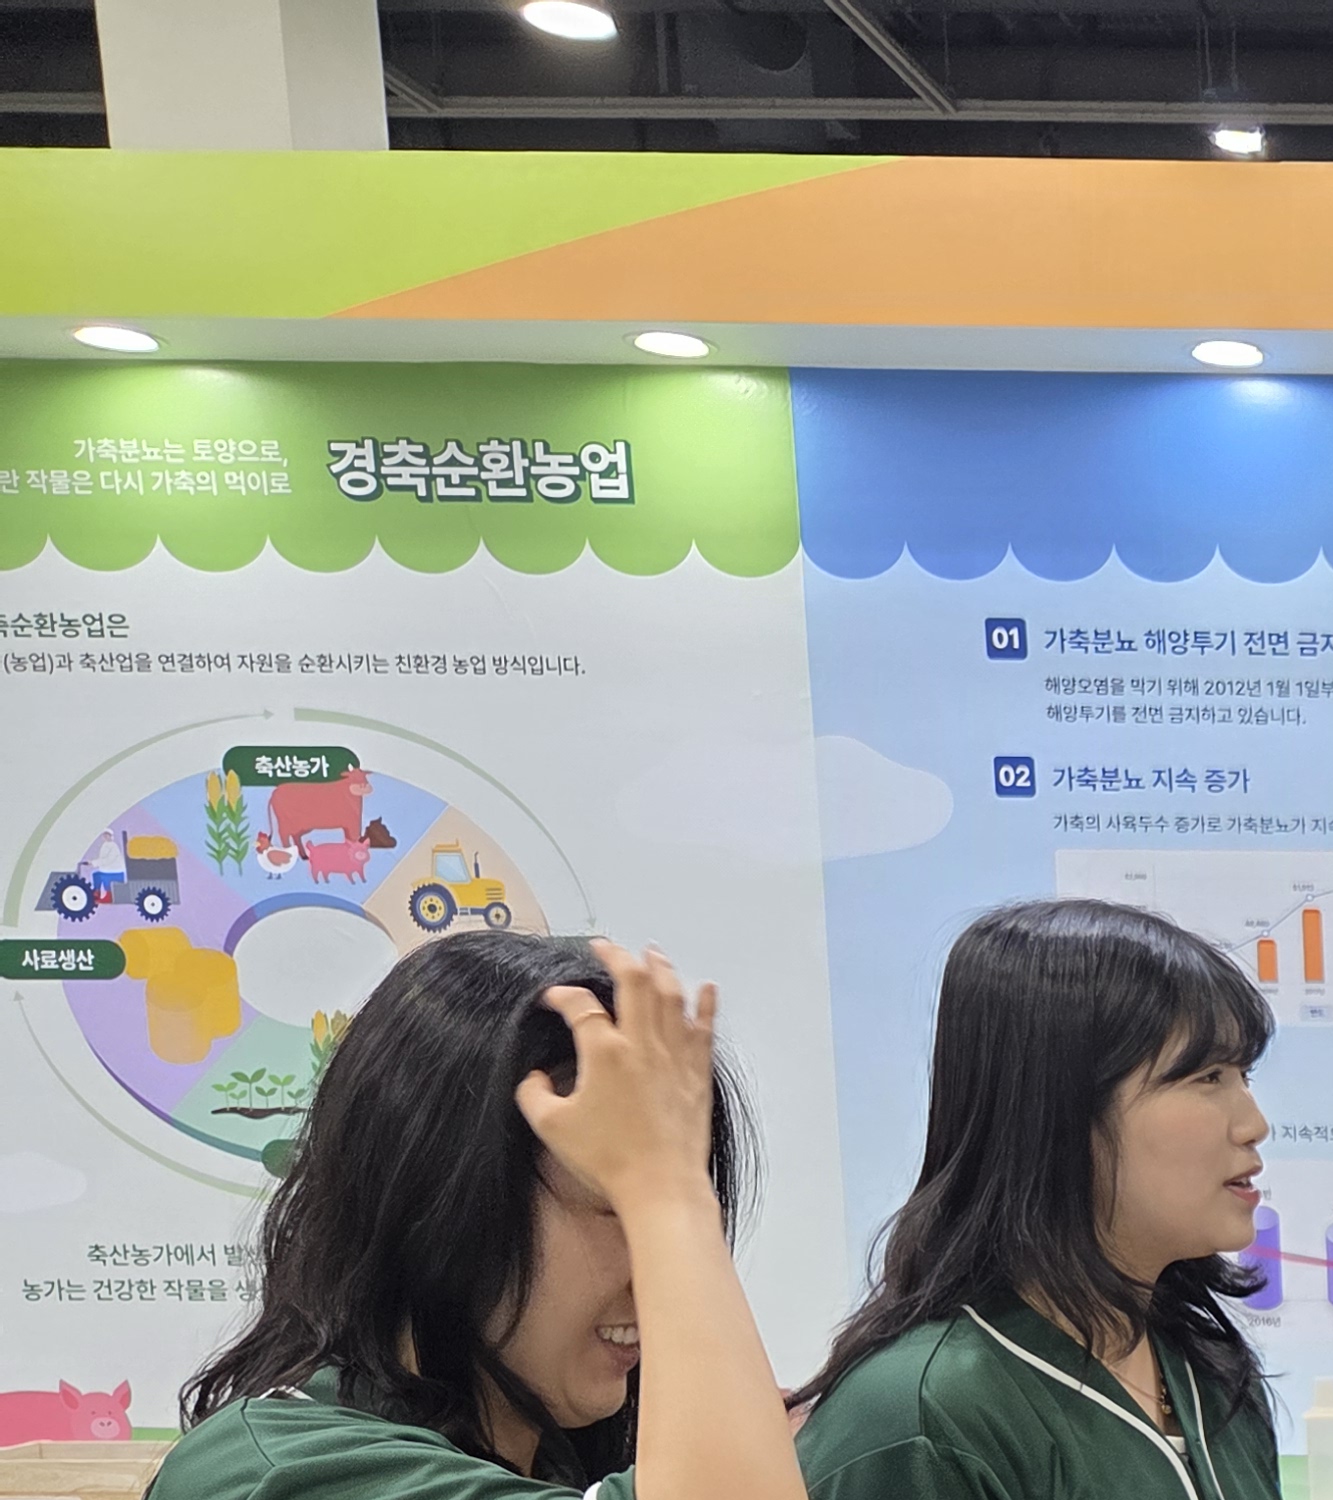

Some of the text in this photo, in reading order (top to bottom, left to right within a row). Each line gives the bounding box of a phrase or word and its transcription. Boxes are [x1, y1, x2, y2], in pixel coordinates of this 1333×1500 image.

[74, 438, 289, 467] 가축분뇨는 토양으로,
[328, 438, 632, 503] 경축순환농업
[24, 469, 94, 495] 작물은
[99, 469, 144, 495] 다시
[150, 469, 218, 496] 가축의
[223, 470, 292, 496] 먹이로
[991, 627, 1021, 650] 01
[1045, 628, 1138, 654] 가축분뇨
[1144, 629, 1236, 656] 해양투기
[1243, 630, 1290, 656] 전면
[3, 652, 586, 676] (농업)과 축산업을 연결하여 자원을 순환시키는 친환경 농업 방식입니다.
[1045, 676, 1125, 696] 해양오염을
[1130, 677, 1162, 696] 막기
[1167, 678, 1199, 696] 위해
[1203, 679, 1261, 698] 2012년
[1266, 679, 1290, 698] 1월
[1046, 704, 1306, 726] 해양투기를 전면 금지하고 있습니다.
[255, 755, 329, 778] 축산농가
[999, 765, 1031, 788] 02
[1053, 766, 1250, 794] 가축분뇨 지속 증가
[1053, 813, 1101, 833] 가축의
[1106, 815, 1169, 833] 사육두수
[1174, 816, 1221, 834] 증가로
[1227, 816, 1306, 835] 가축분뇨가
[21, 948, 95, 971] 사료생산
[88, 1244, 216, 1267] 축산농가에서
[22, 1279, 228, 1301] 농가는 건강한 작물을
